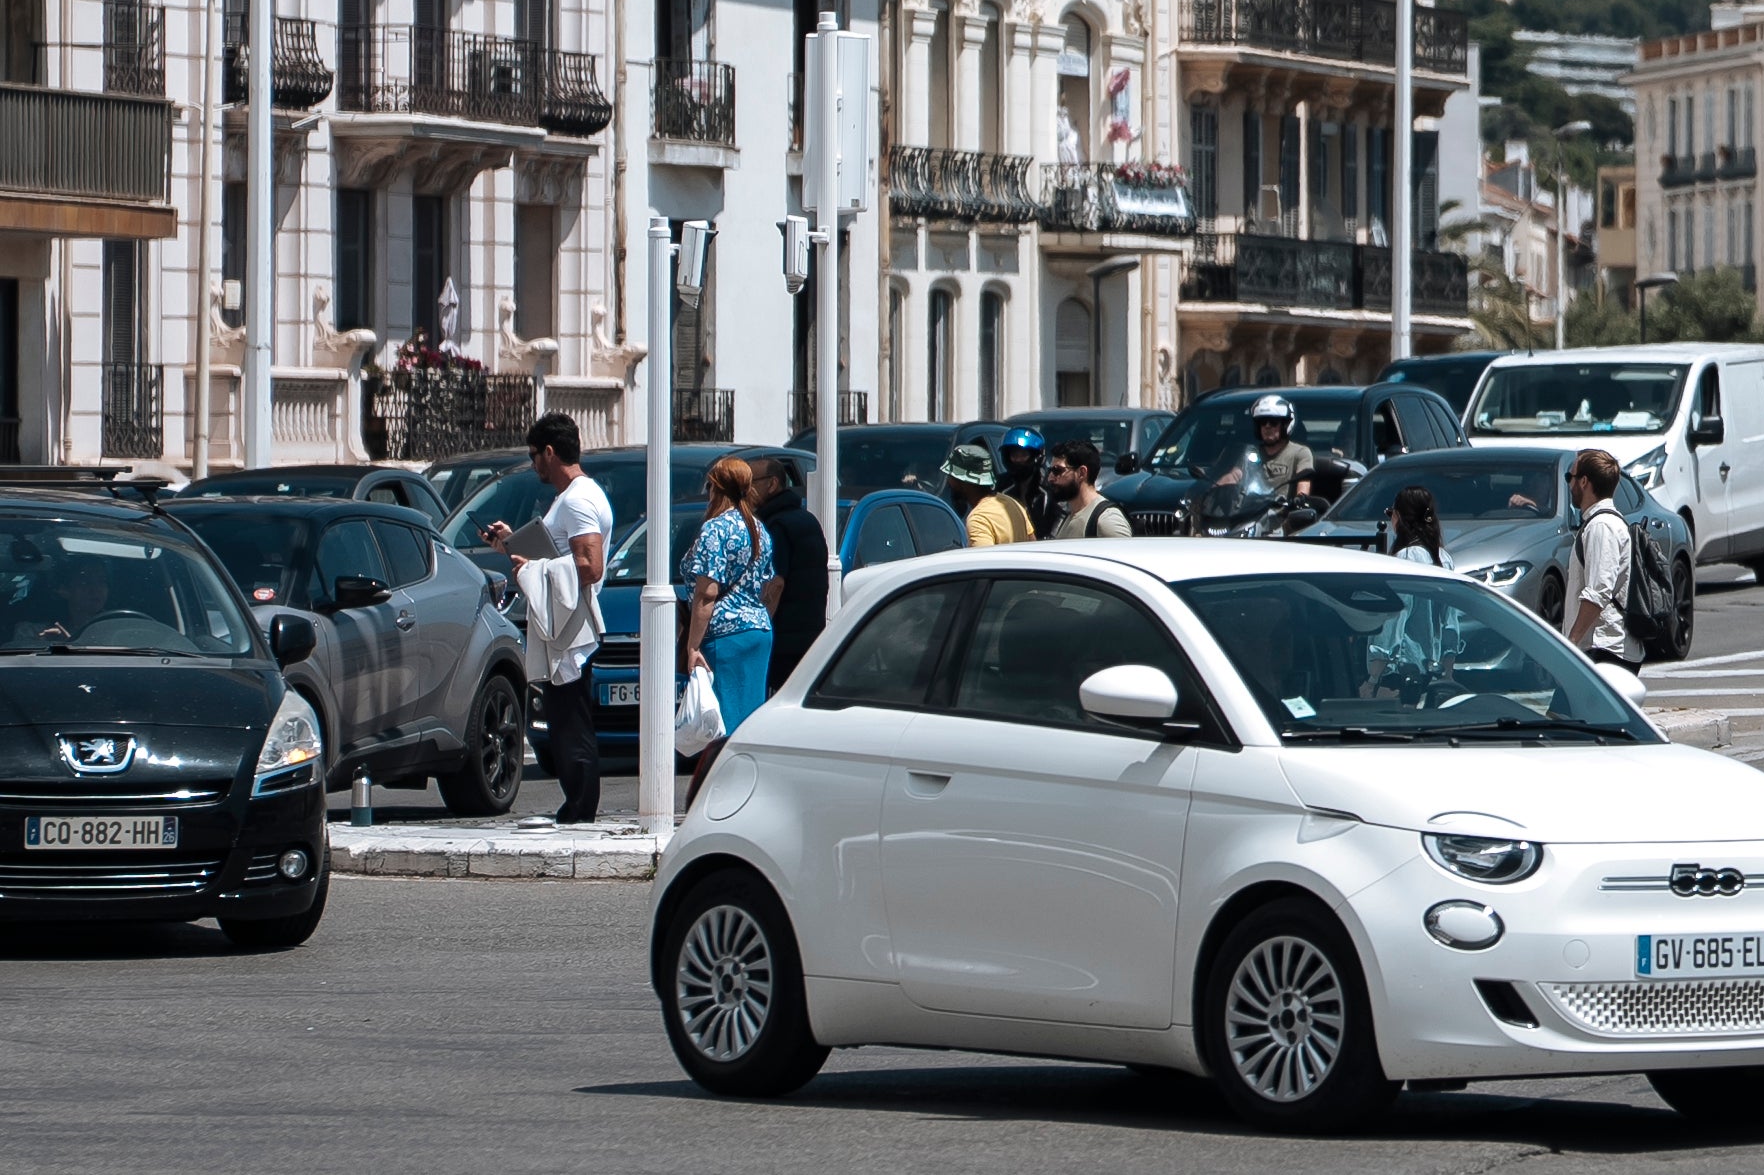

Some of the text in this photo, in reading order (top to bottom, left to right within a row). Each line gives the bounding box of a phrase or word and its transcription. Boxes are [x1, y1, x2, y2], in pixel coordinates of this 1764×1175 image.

[44, 821, 160, 845] CQ-882-HH
[163, 832, 175, 843] 26
[1669, 863, 1745, 897] 500
